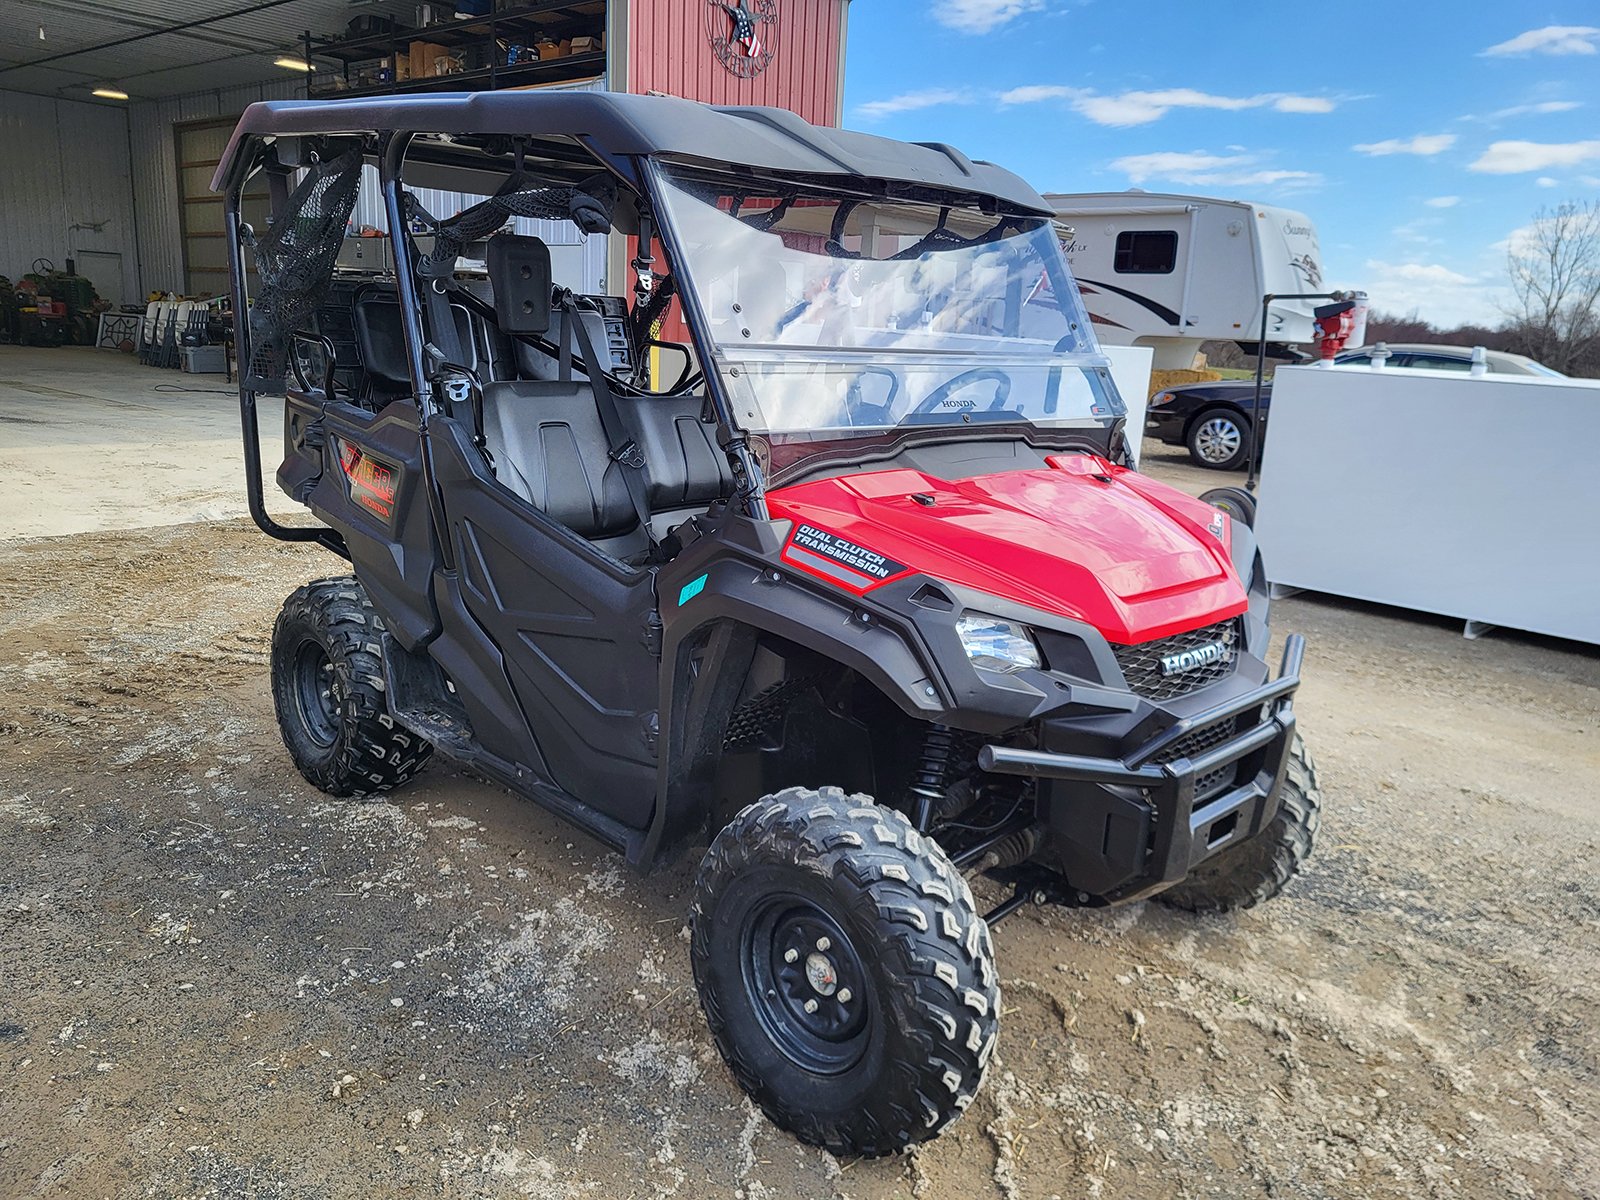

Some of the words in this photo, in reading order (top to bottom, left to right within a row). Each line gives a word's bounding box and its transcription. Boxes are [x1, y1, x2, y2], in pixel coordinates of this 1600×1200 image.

[942, 400, 977, 408] HONDA
[361, 495, 390, 517] HONDA
[794, 532, 890, 578] TRANSMISSION
[799, 525, 832, 544] DUAL
[834, 539, 886, 566] CLUTCH
[1162, 640, 1227, 676] HONDA
